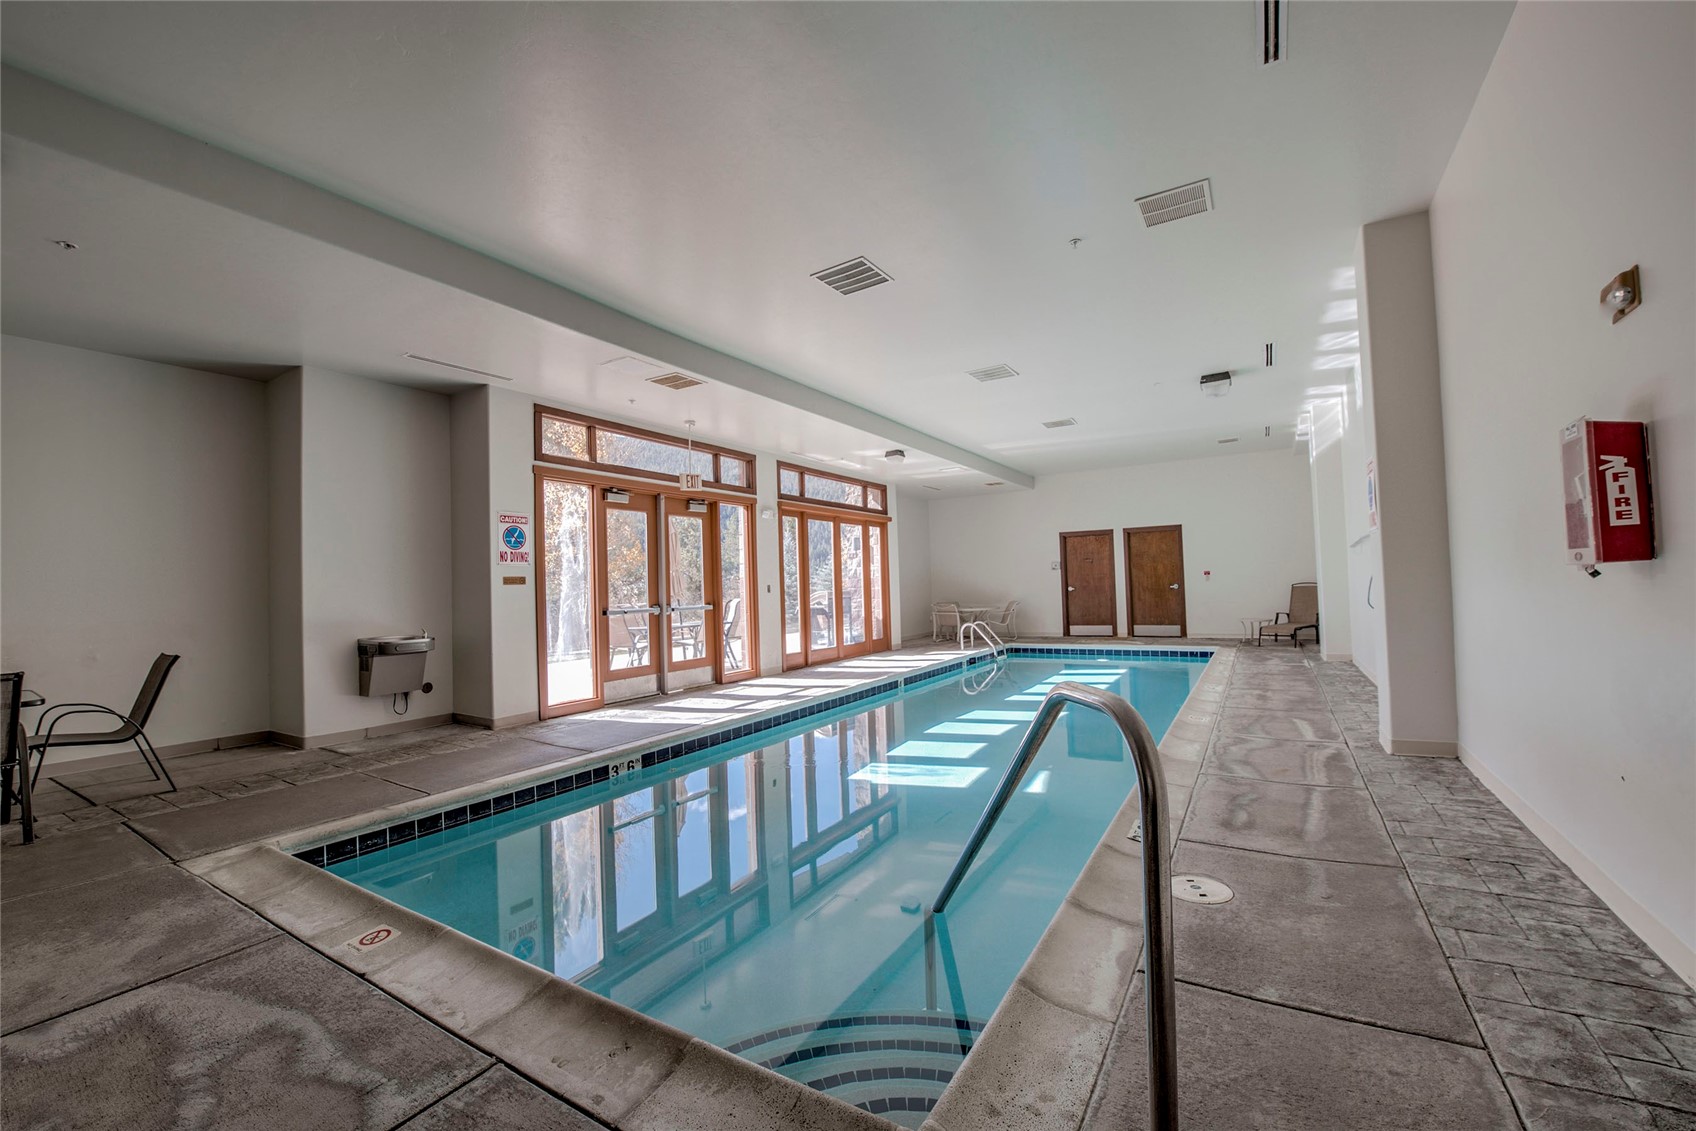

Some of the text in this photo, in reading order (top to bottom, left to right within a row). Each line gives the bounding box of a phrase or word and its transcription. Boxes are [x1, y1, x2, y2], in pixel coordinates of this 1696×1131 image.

[686, 474, 700, 488] EXIT
[1611, 471, 1633, 520] FIRE
[500, 551, 509, 562] NO
